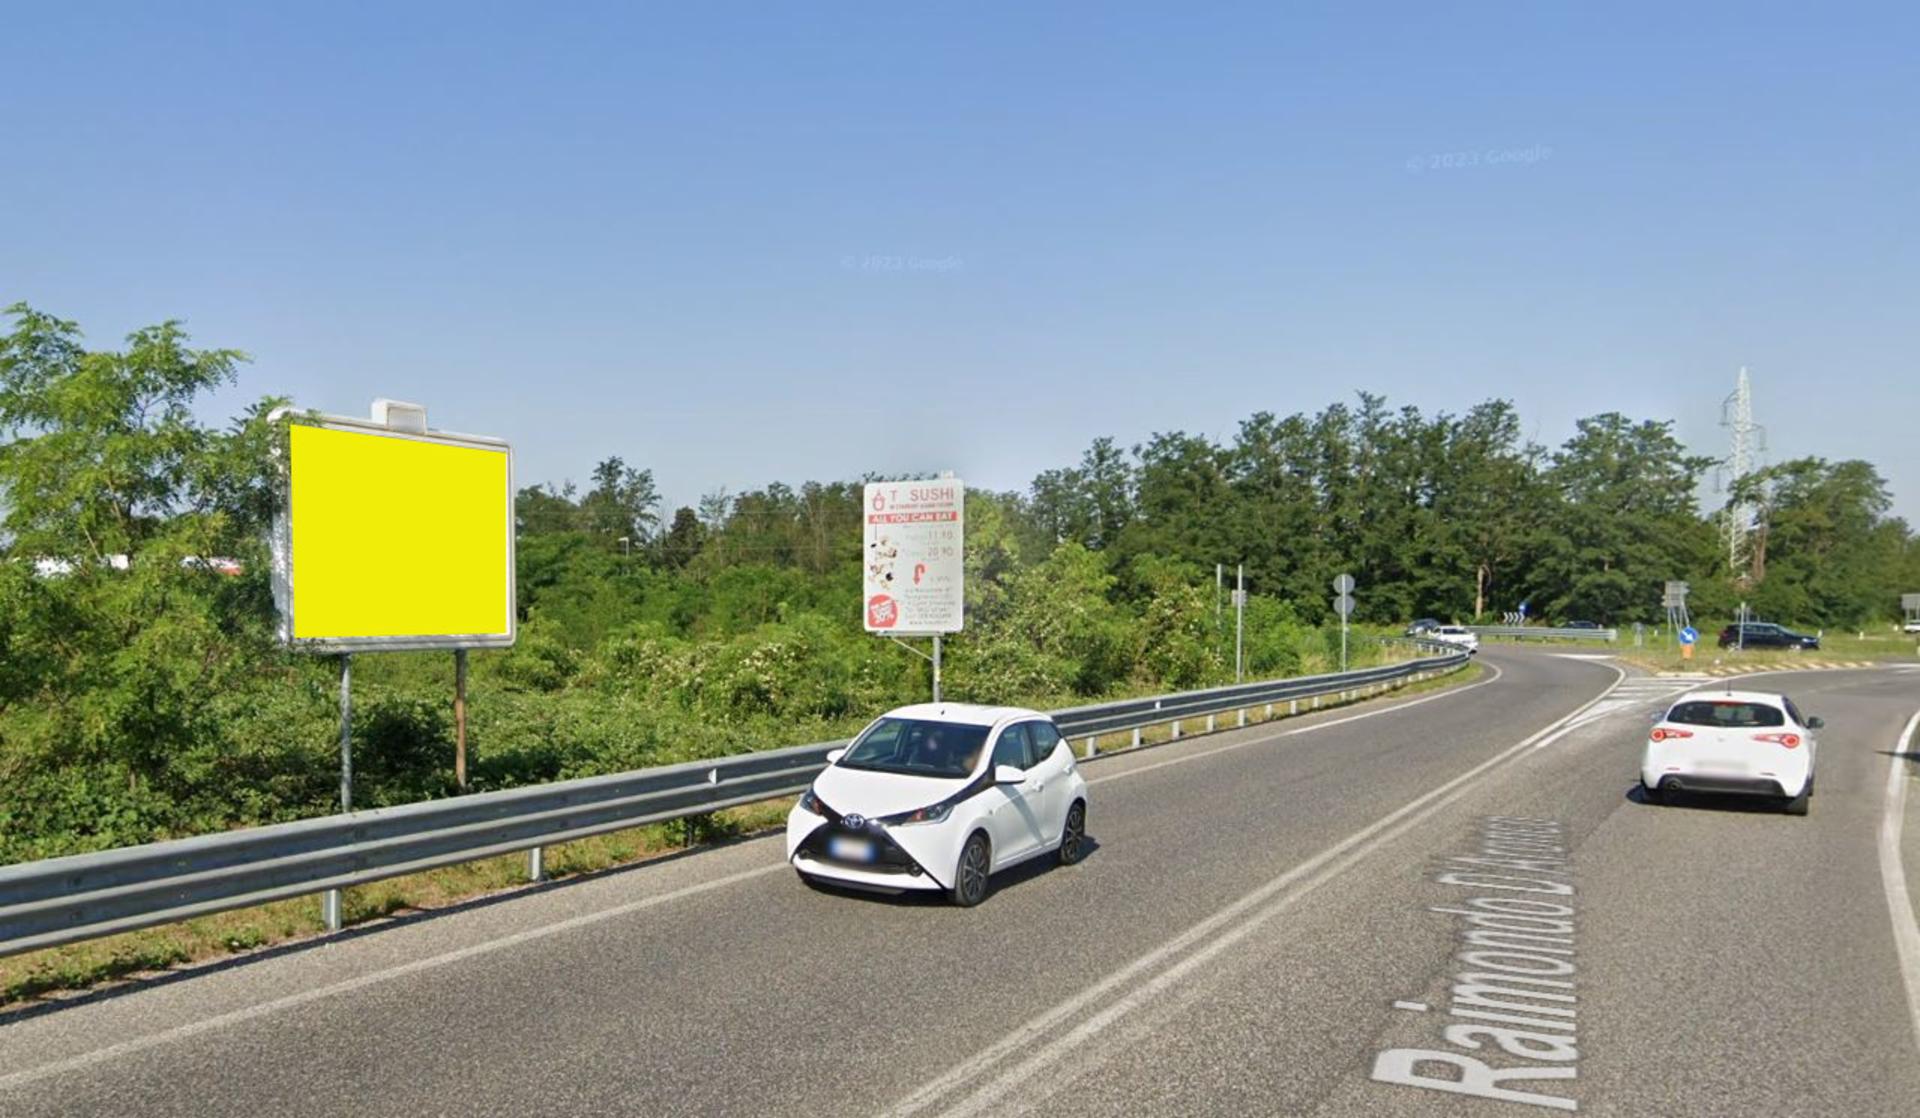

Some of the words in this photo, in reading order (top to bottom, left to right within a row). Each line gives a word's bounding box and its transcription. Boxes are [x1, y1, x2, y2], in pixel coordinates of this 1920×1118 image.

[910, 487, 955, 502] SUSHI
[872, 515, 887, 524] ALL
[890, 514, 909, 523] YOU
[912, 513, 933, 522] CAN
[936, 512, 953, 521] EAT
